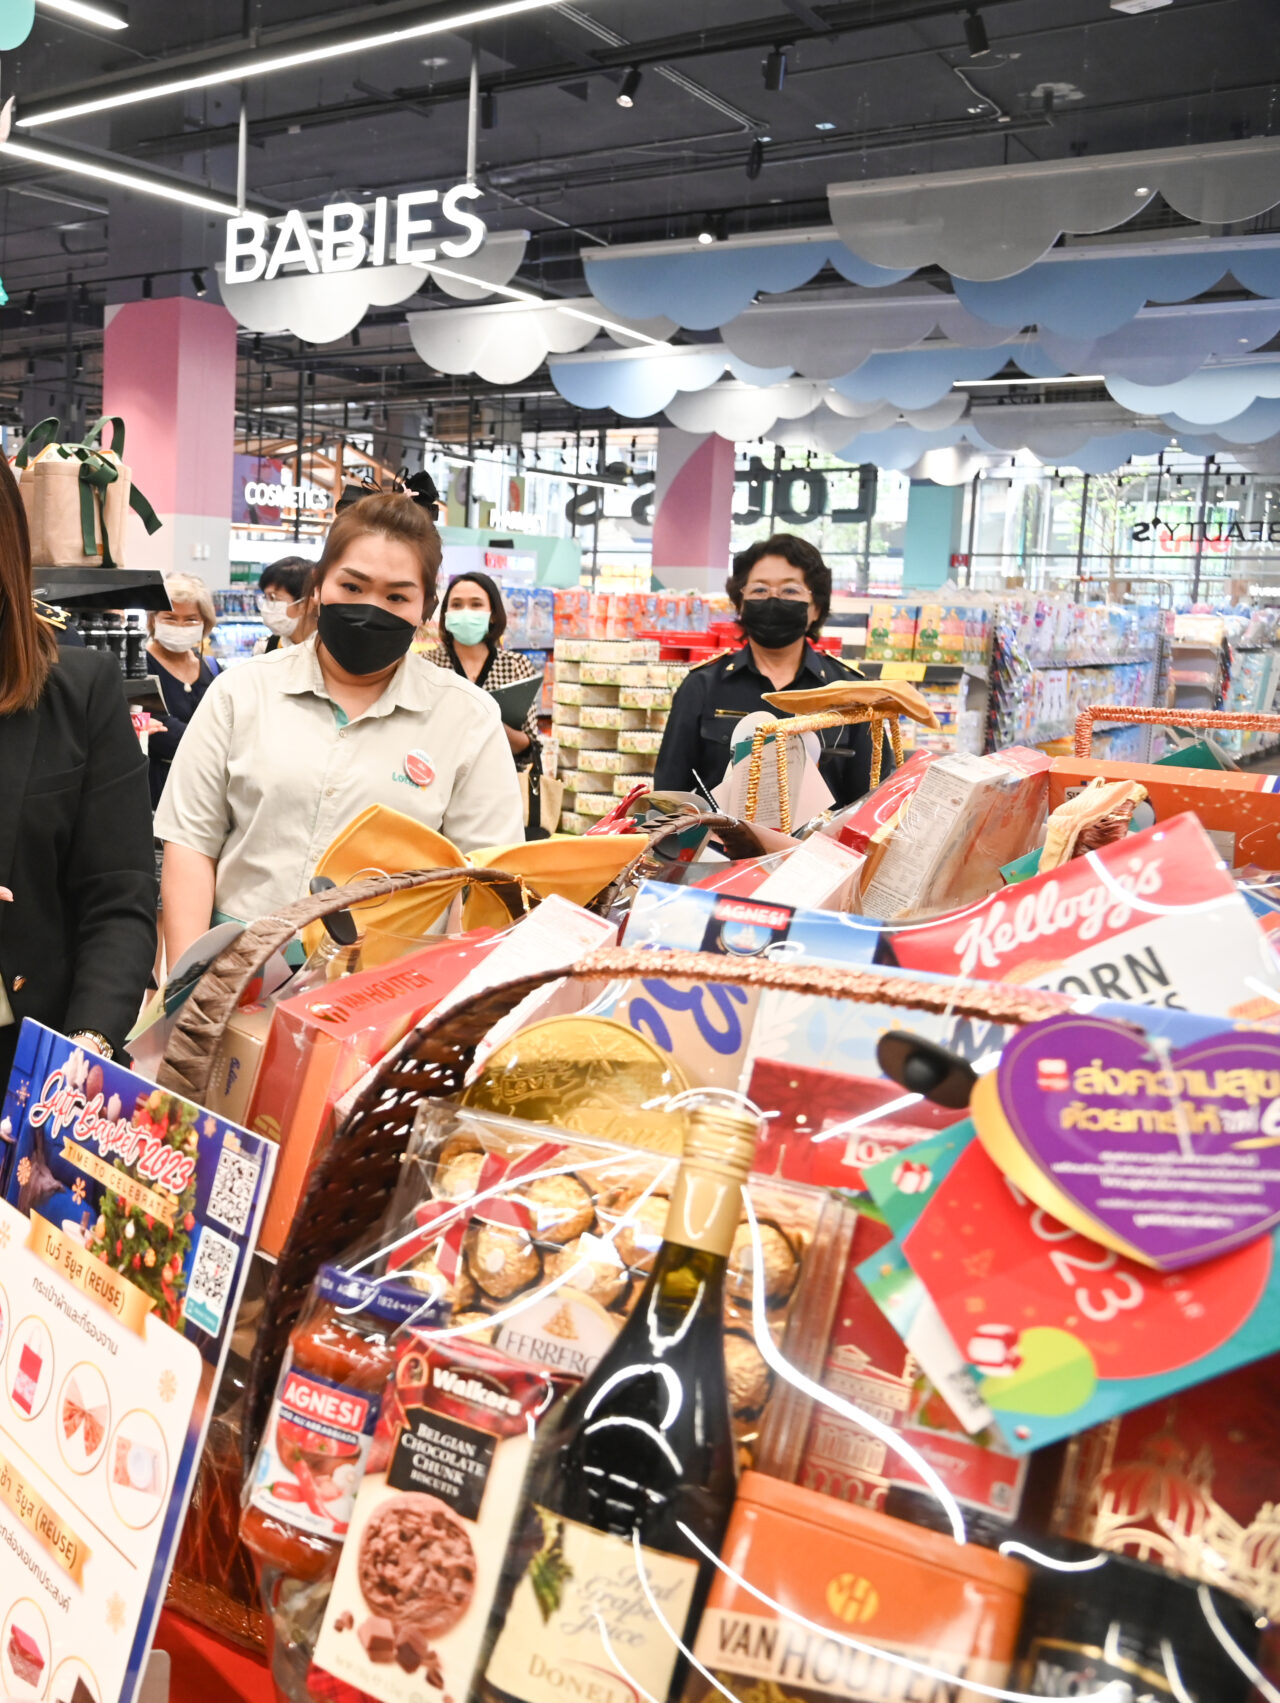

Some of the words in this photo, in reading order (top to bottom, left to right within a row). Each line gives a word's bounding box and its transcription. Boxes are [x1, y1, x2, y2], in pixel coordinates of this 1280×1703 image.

[225, 182, 484, 285] BABIES
[244, 481, 329, 511] COSMETICS
[720, 903, 786, 926] AGNESI
[953, 857, 1165, 968] Kellogg's
[361, 968, 435, 1005] HOUTEN
[1034, 945, 1172, 1000] ORN
[29, 1068, 86, 1138] Gift
[73, 1093, 144, 1168] Basket
[135, 1136, 196, 1195] 2023
[68, 1145, 90, 1168] TIME
[93, 1159, 105, 1179] TO
[109, 1170, 169, 1219] CELEBRATE
[45, 1234, 62, 1260] โบว์
[83, 1265, 125, 1315] (REUSE)
[283, 1380, 362, 1427] AGNESI
[432, 1367, 523, 1416] Walkers
[400, 1432, 487, 1478] CHOCOLATE
[417, 1422, 477, 1458] BELGIAN
[410, 1468, 460, 1497] BISCUITS
[412, 1453, 465, 1486] CHUNK
[35, 1506, 78, 1570] (REUSE)
[719, 1618, 779, 1661] VAN
